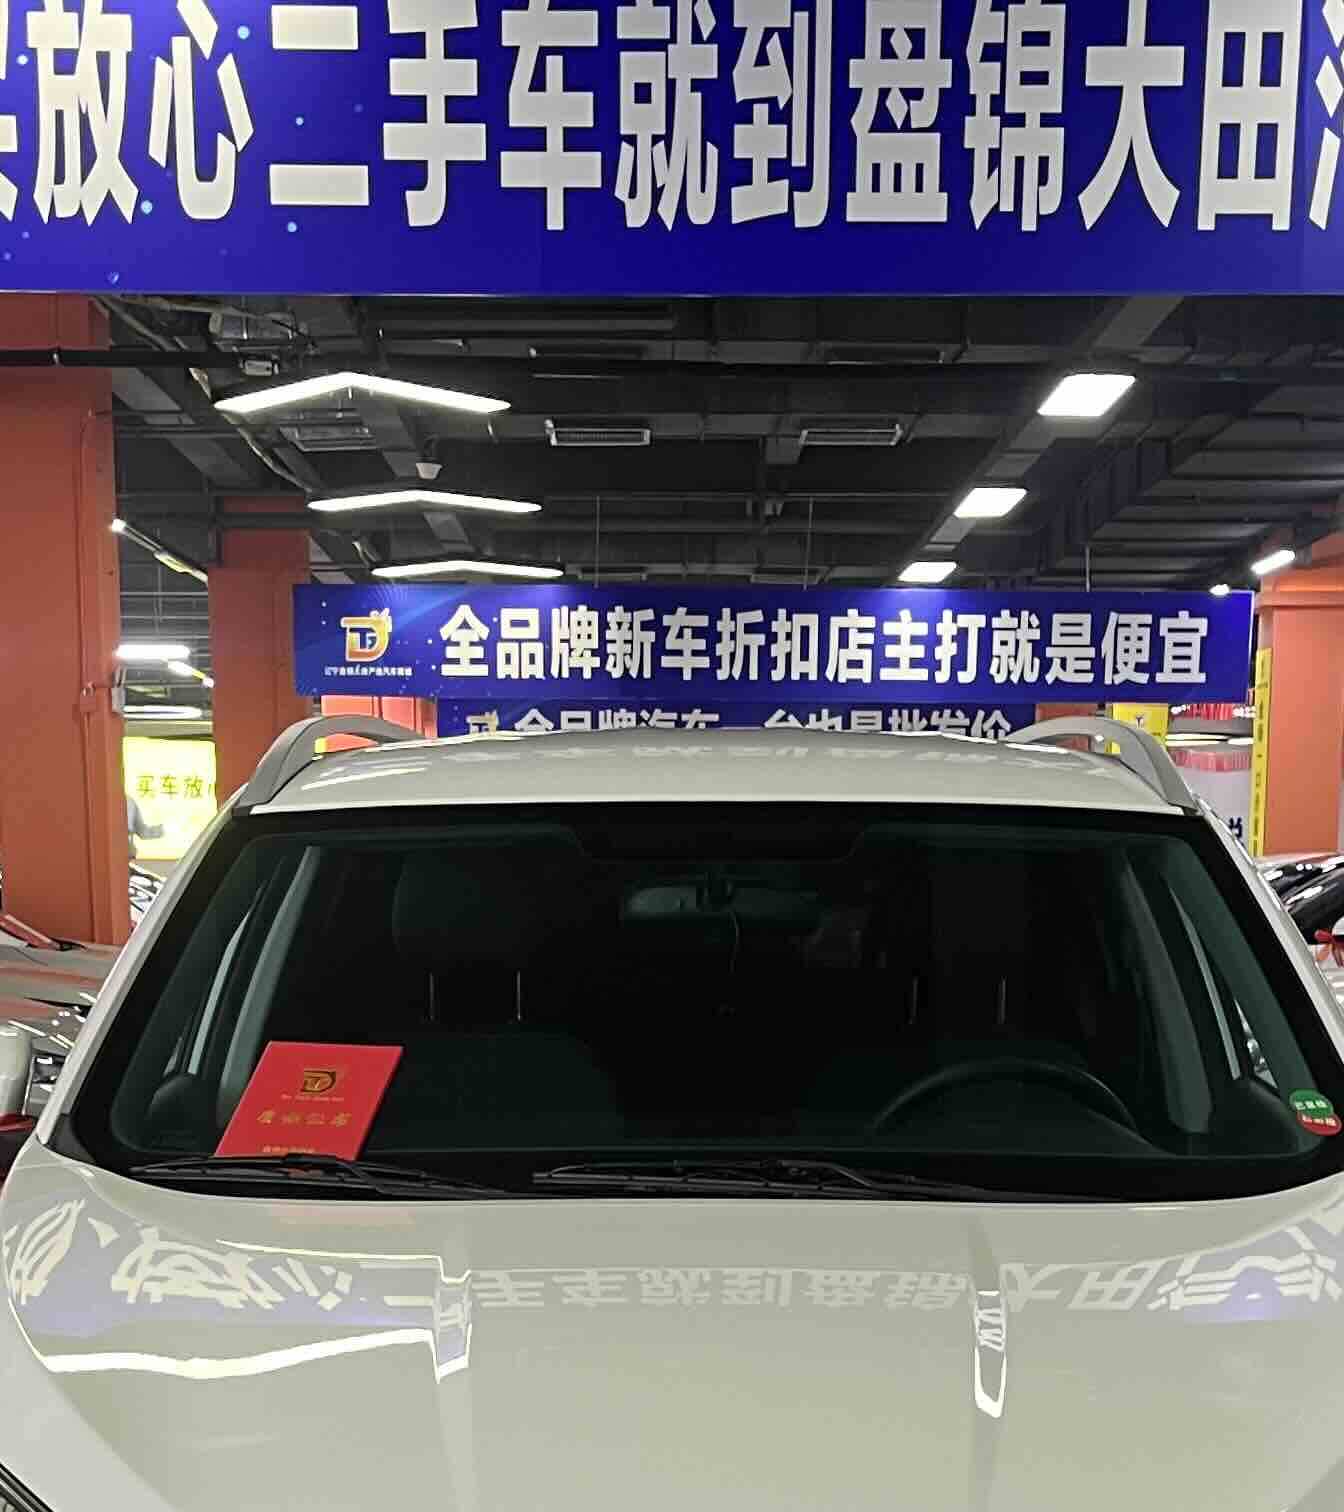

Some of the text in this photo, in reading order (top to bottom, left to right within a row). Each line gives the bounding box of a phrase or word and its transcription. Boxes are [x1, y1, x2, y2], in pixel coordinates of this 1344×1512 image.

[439, 603, 1209, 686] 全品牌新车折扣店主打就是便宜
